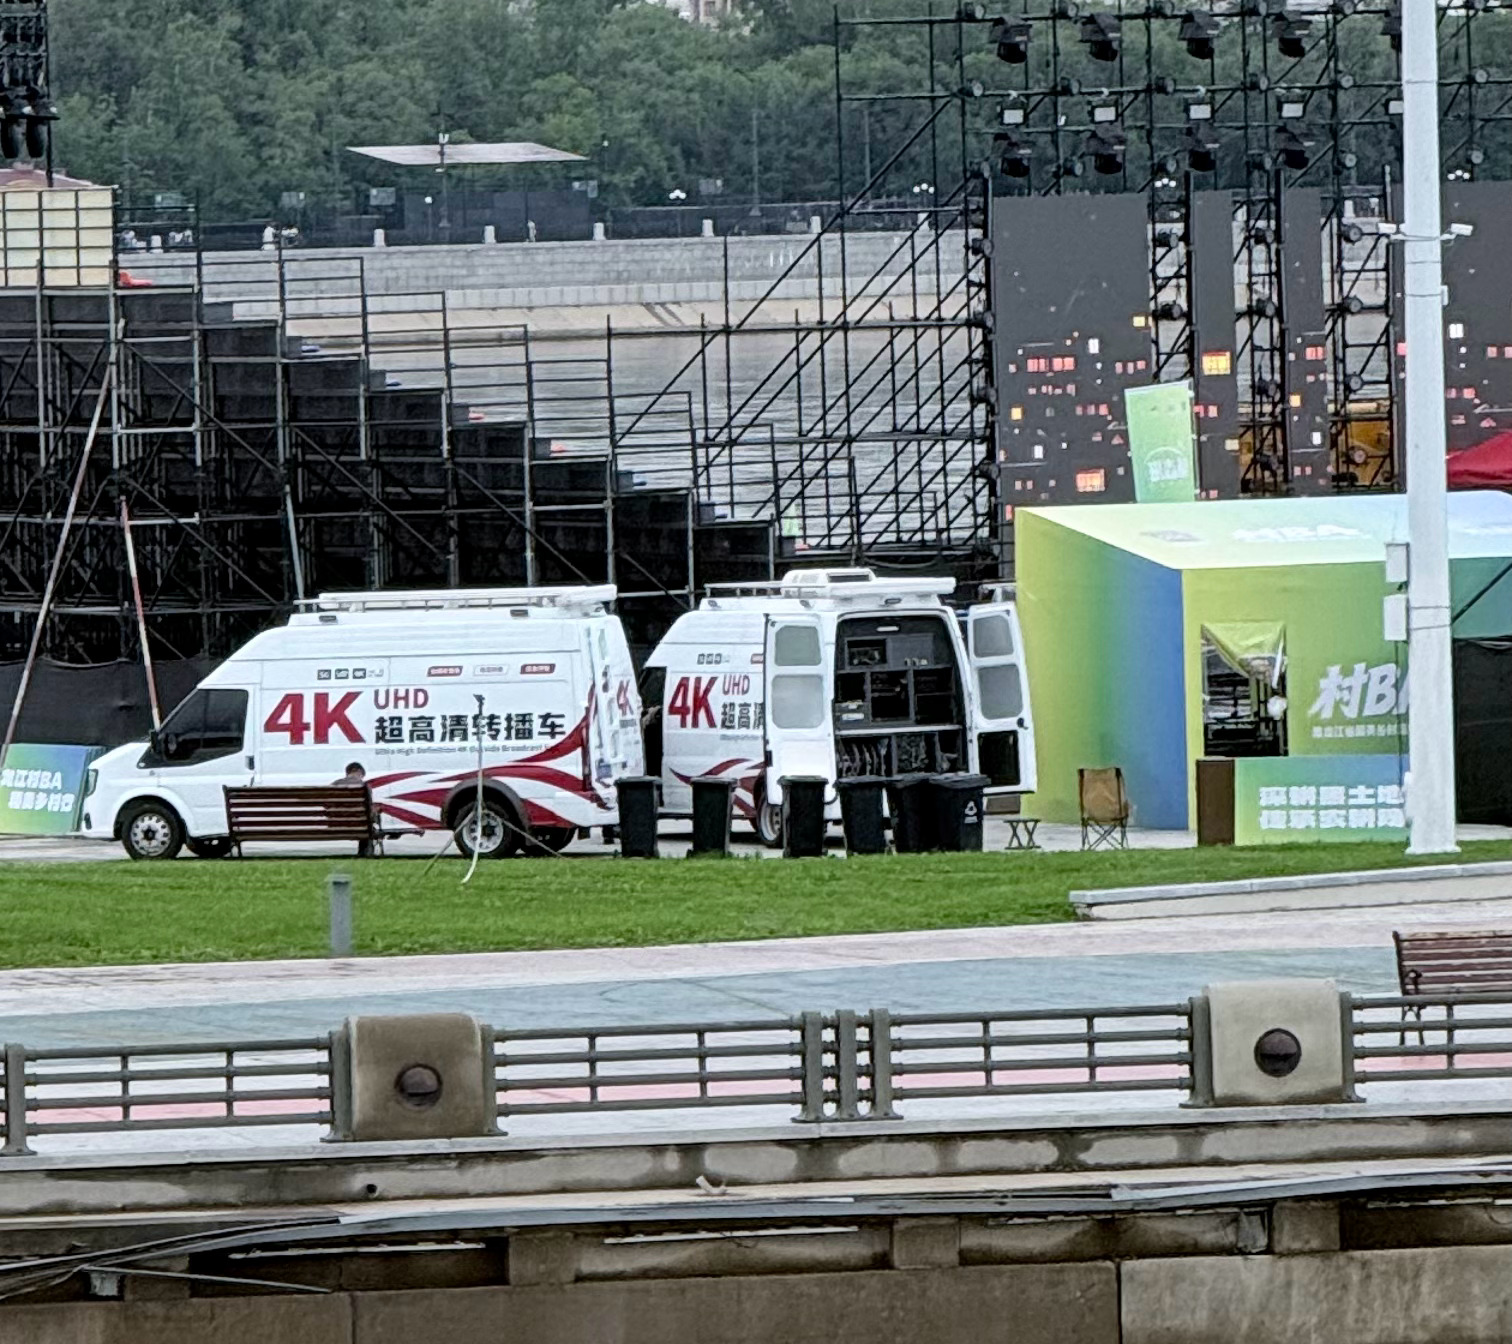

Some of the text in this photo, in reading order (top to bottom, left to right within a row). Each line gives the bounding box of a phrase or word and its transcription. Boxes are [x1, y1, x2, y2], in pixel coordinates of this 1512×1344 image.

[374, 688, 429, 710] UHD
[722, 674, 750, 695] UHD
[264, 690, 366, 745] 4K
[668, 676, 718, 728] 4K
[374, 712, 566, 744] 超高清转播车
